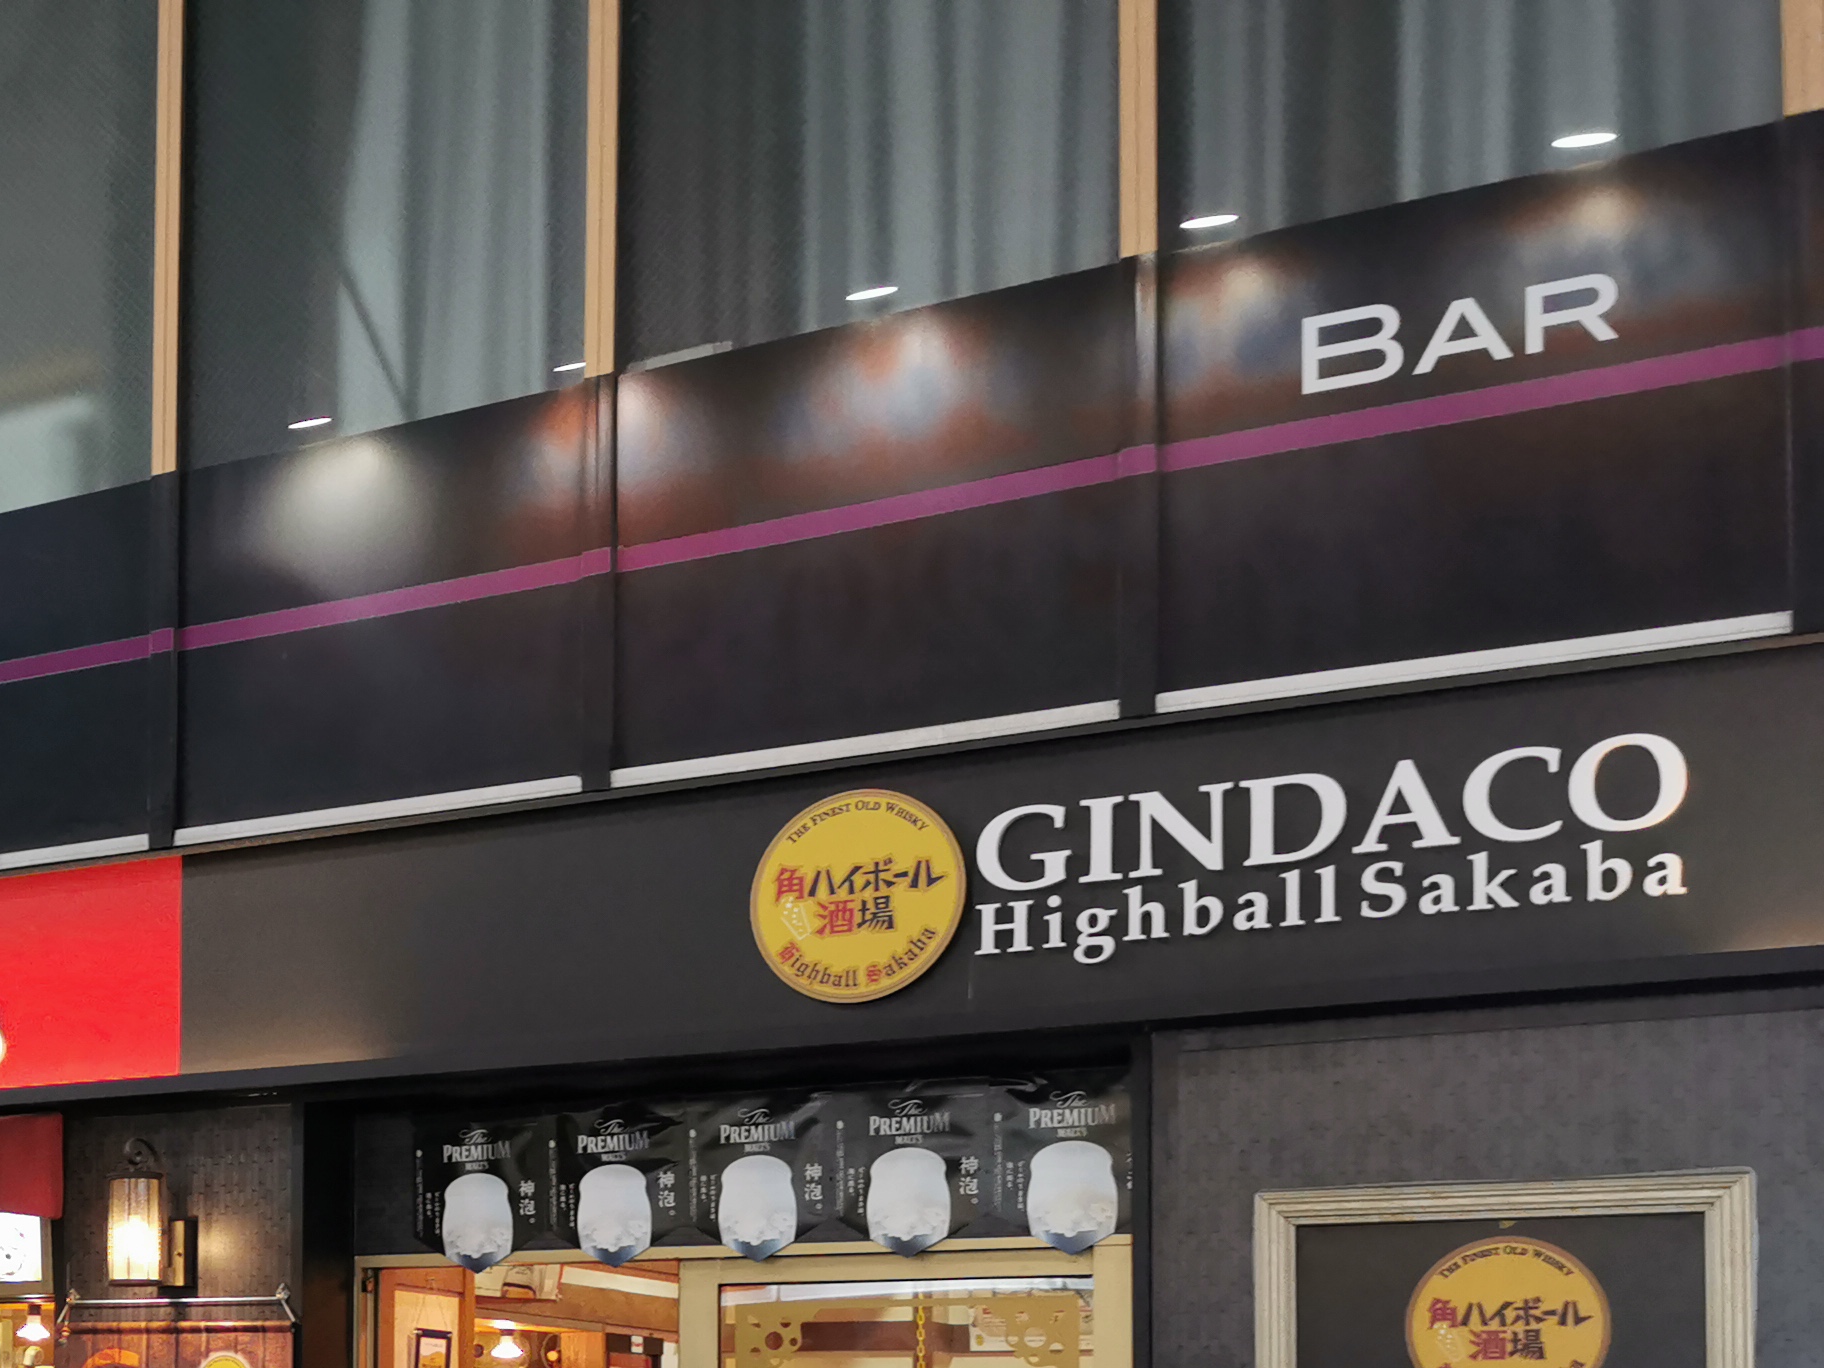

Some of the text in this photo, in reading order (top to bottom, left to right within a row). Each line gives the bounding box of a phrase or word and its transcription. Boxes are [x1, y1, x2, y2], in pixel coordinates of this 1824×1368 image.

[1301, 273, 1619, 394] BAR
[786, 800, 929, 844] THE FINEST OLD WHISKY
[976, 733, 1689, 892] GINDACO
[775, 856, 947, 903] 角ハイボール
[816, 895, 895, 937] 酒場
[974, 839, 1689, 965] Highball Sakaba
[719, 1121, 796, 1144] PREMIUM
[868, 1111, 951, 1136] PREMIUM
[1028, 1104, 1117, 1129] PREMIUM
[442, 1140, 512, 1164] PREMIUM
[577, 1130, 651, 1154] PREMIUM
[1428, 1296, 1594, 1329] 角ハイボール
[1469, 1328, 1546, 1361] 酒場
